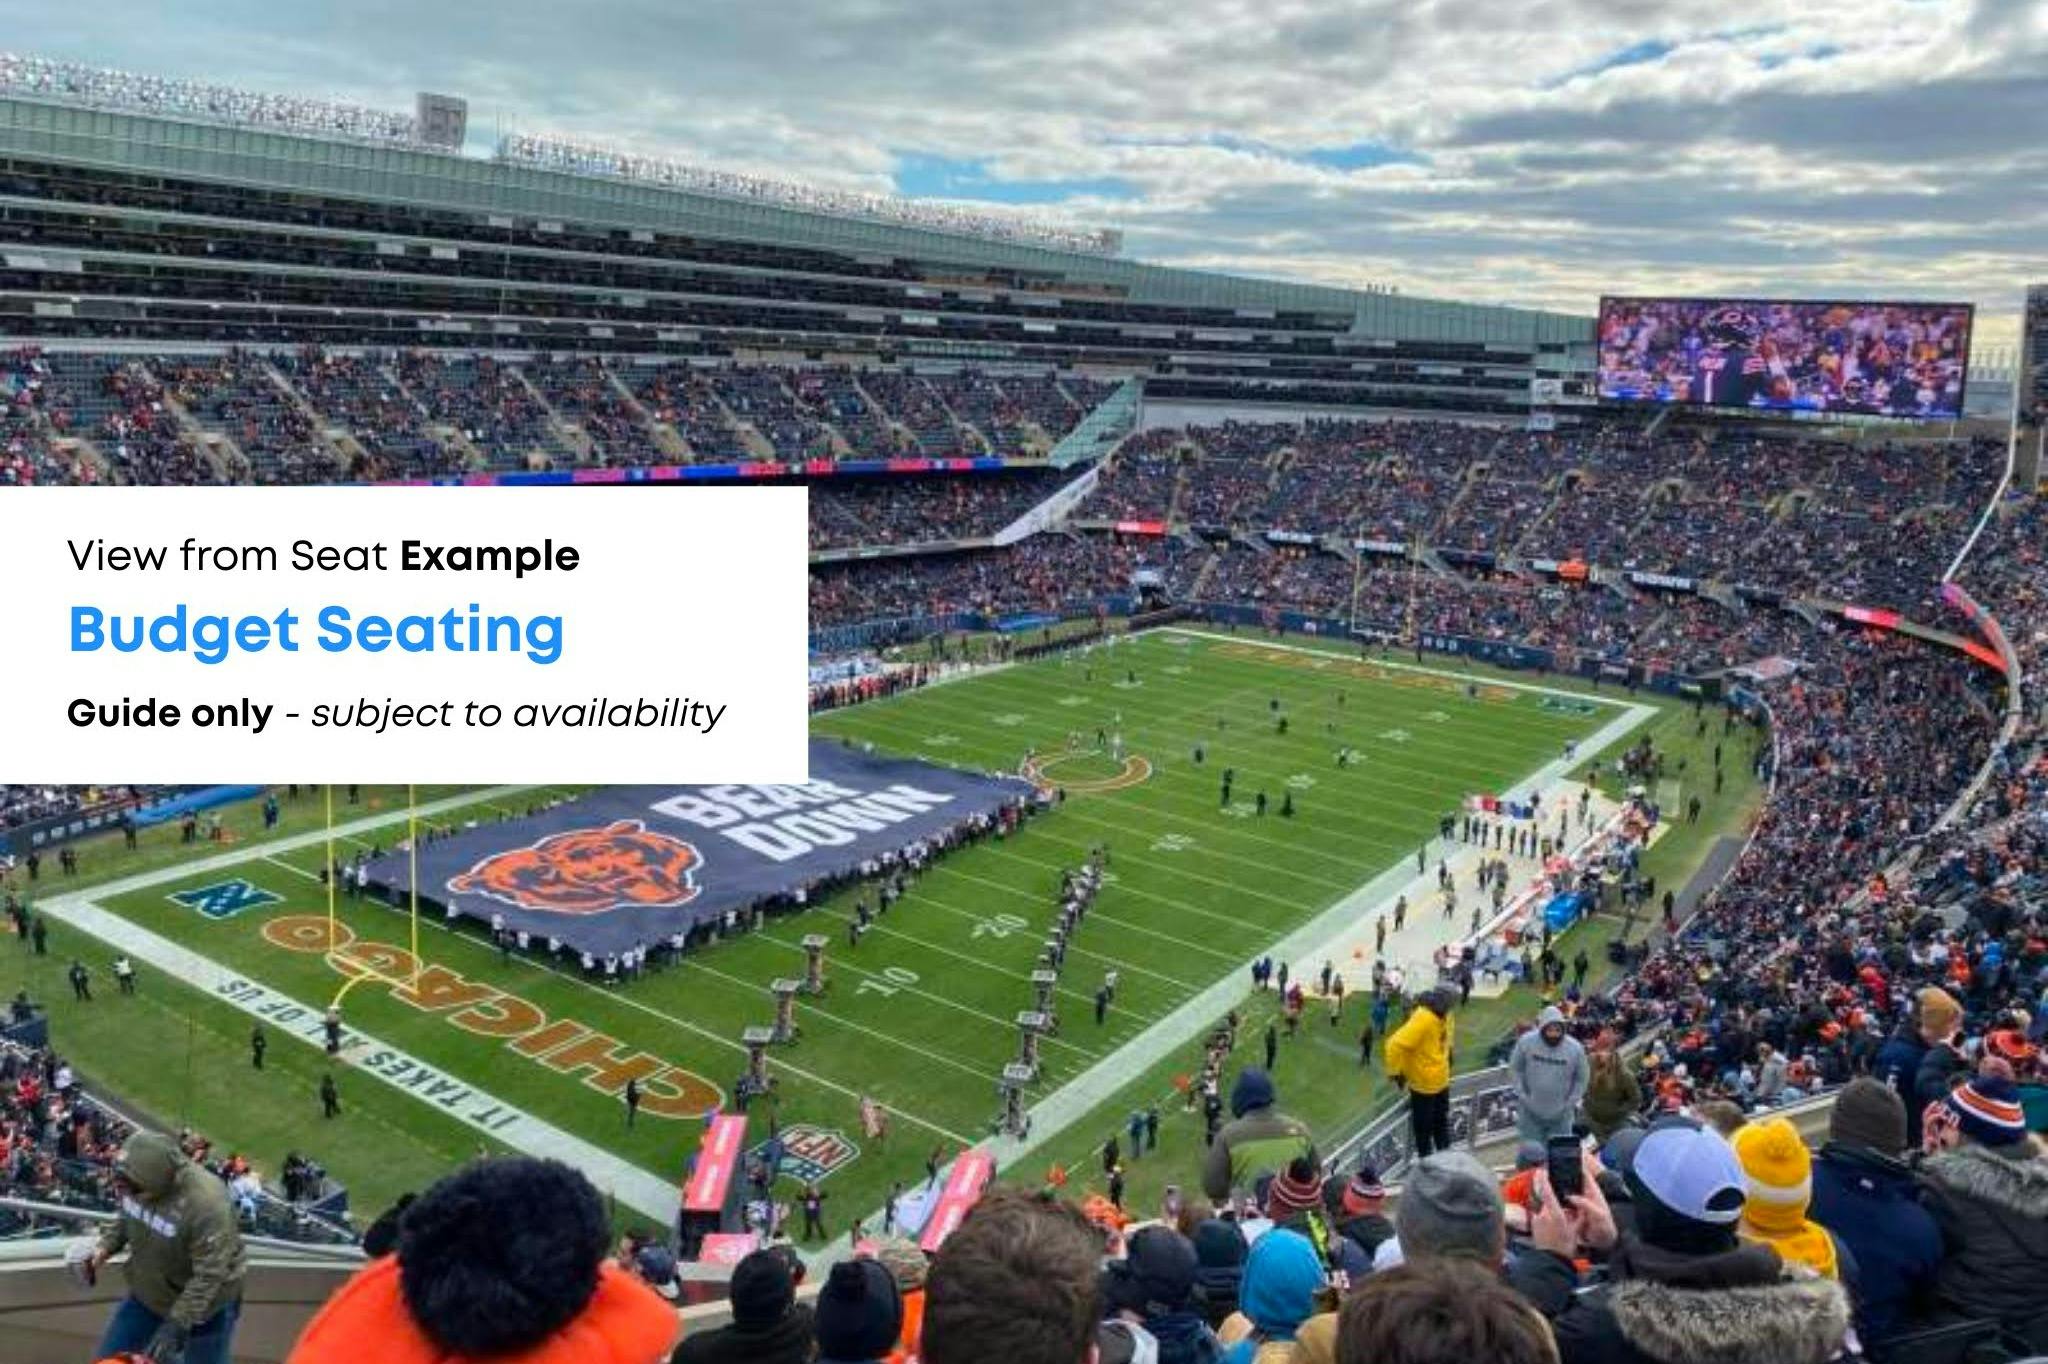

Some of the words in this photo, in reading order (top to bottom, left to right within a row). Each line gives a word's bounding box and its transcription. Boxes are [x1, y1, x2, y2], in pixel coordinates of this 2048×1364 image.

[719, 785, 955, 862] DOWN
[216, 978, 264, 1002] US
[255, 1002, 308, 1022] OF
[261, 915, 726, 1120] CHICAGO
[363, 1051, 472, 1107] TAKES
[469, 1105, 521, 1130] IT
